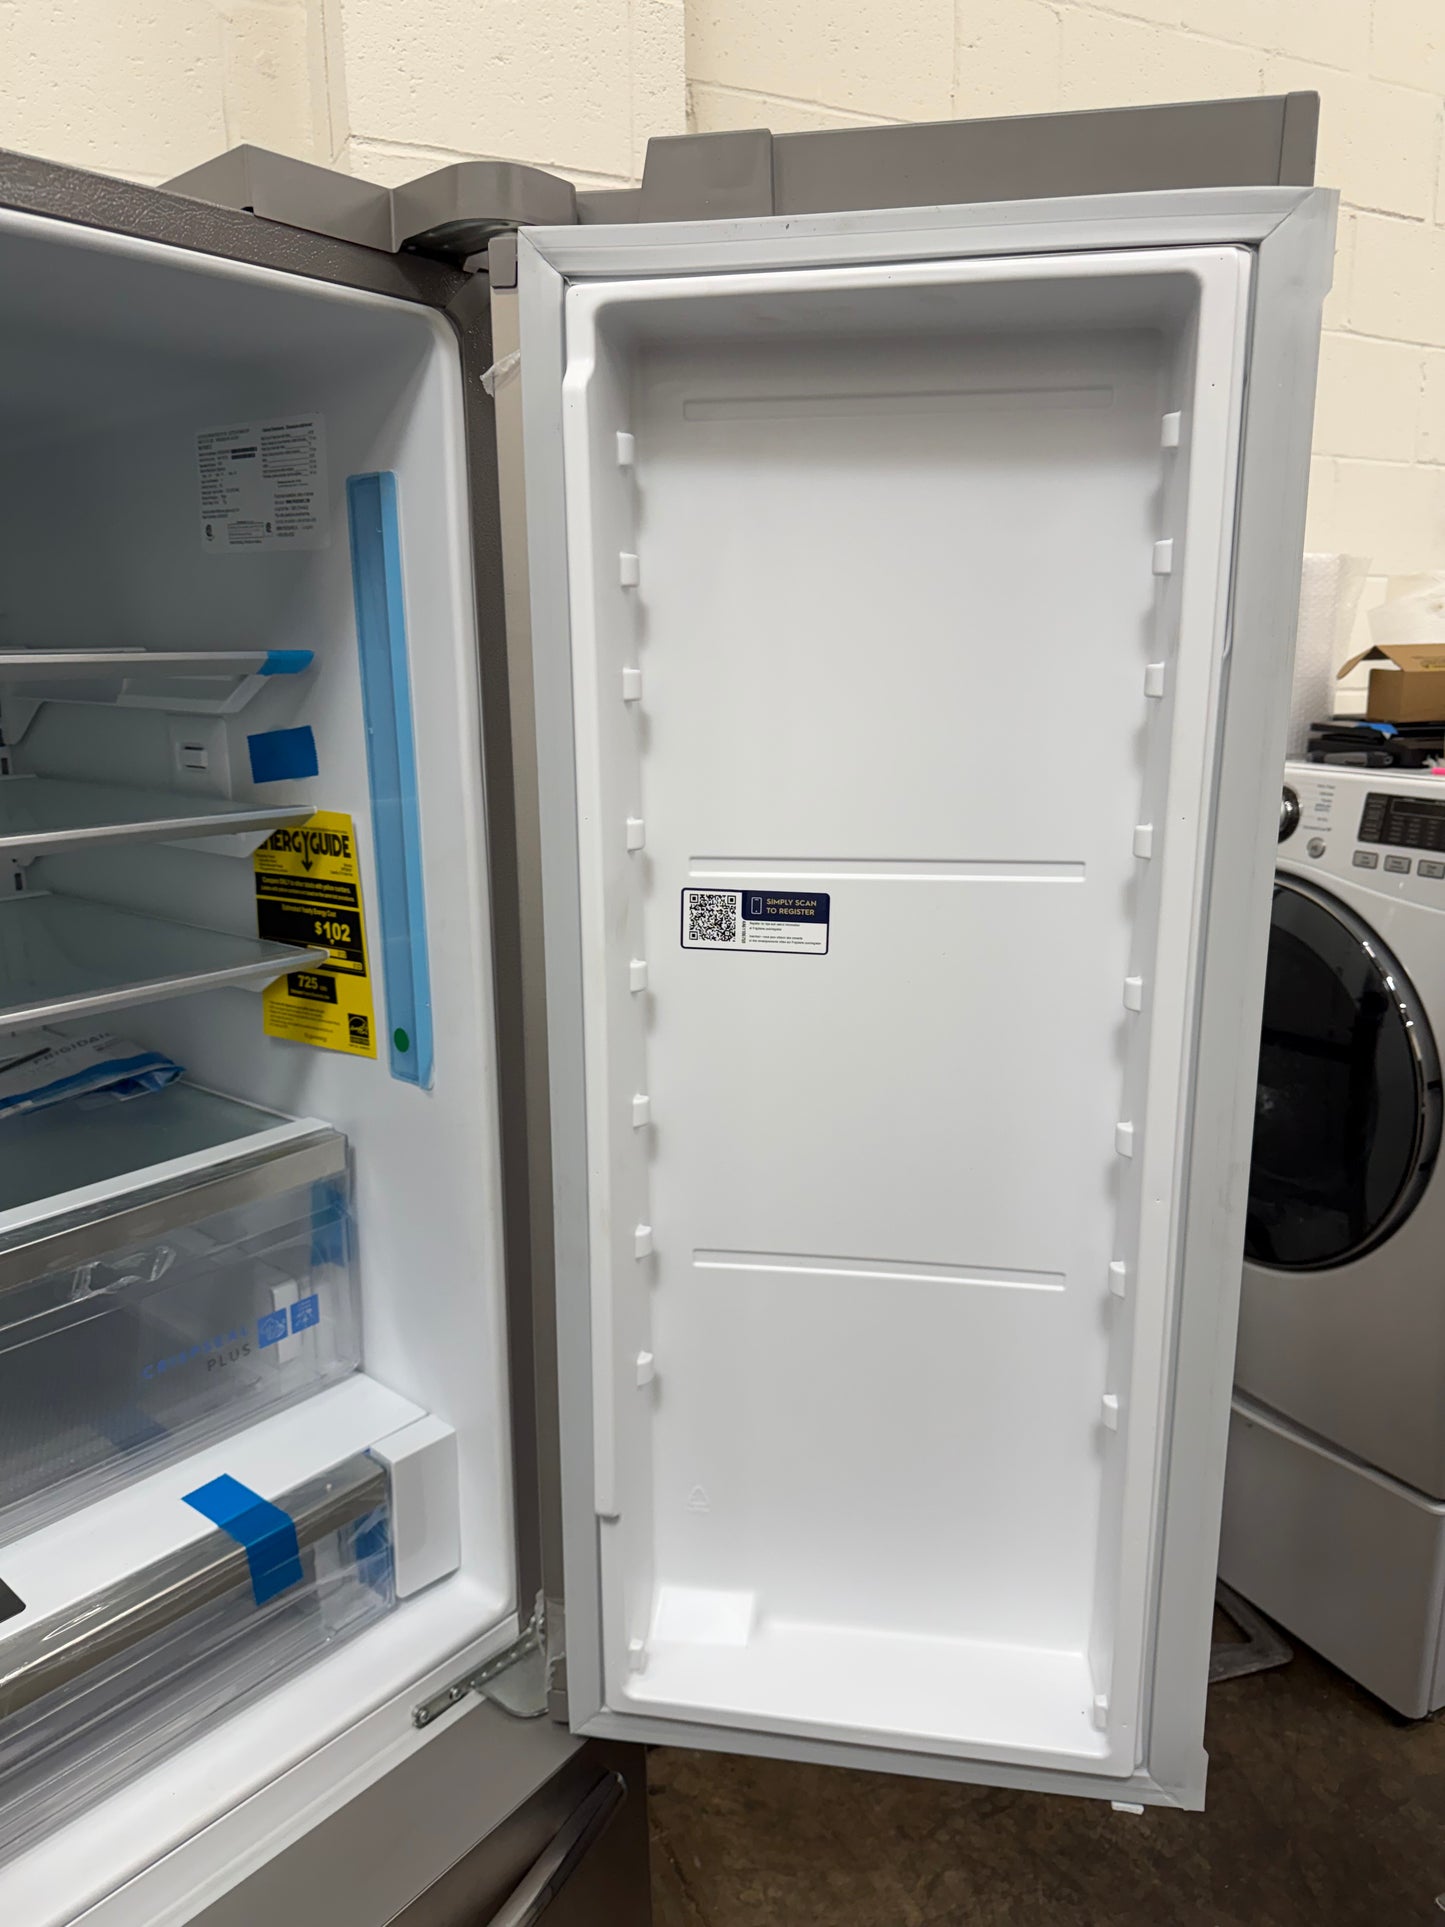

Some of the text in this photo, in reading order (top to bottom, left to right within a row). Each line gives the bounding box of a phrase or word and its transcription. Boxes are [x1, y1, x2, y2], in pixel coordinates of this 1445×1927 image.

[257, 829, 352, 858] NERGYGUIDE
[766, 898, 817, 907] SIMPLY SCAN
[779, 908, 815, 916] REGISTER
[314, 920, 351, 942] $102
[297, 974, 318, 990] 725
[207, 1343, 252, 1372] PLUS
